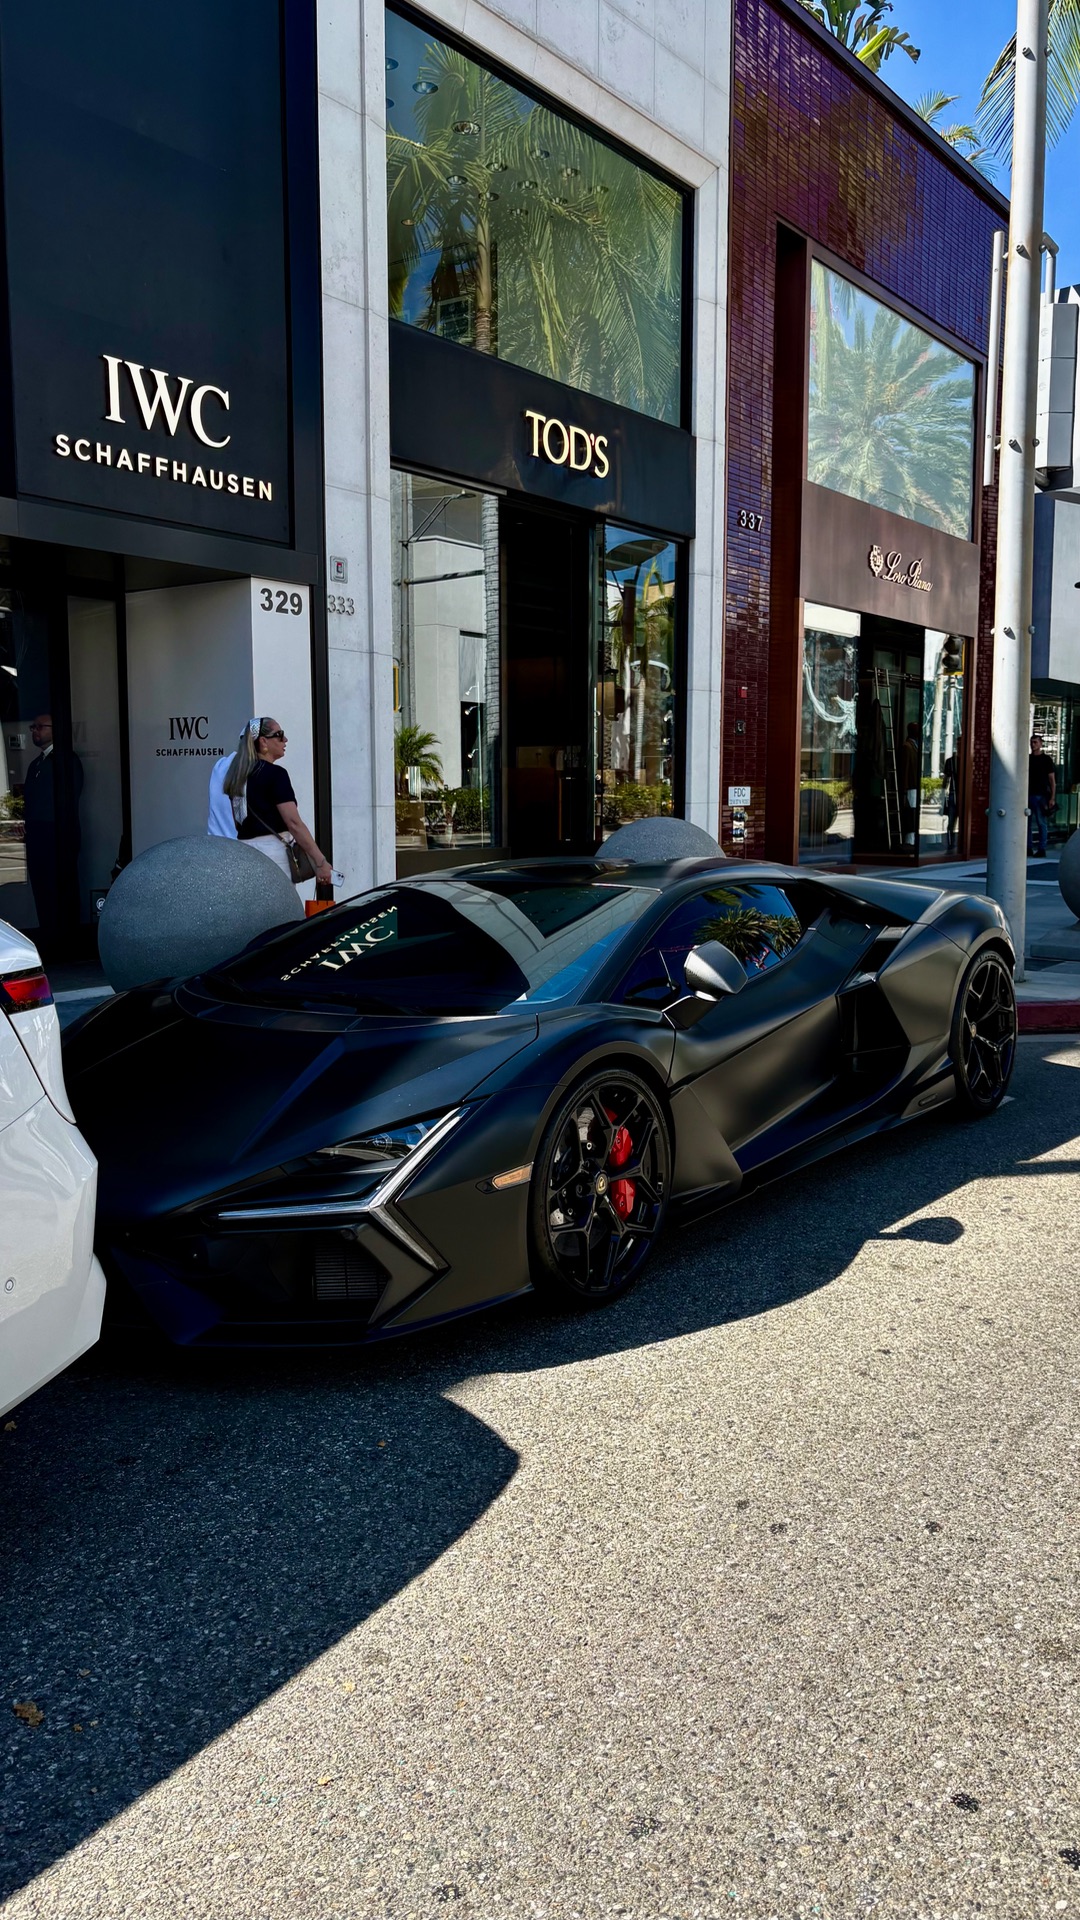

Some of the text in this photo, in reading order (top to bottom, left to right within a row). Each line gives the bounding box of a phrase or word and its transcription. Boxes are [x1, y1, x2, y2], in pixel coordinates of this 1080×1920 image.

[102, 354, 231, 448] IWC
[525, 409, 610, 479] TOD'S
[55, 433, 273, 501] SCHAFFHAUSEN
[739, 509, 763, 532] 337
[882, 550, 933, 592] Loro Piana
[260, 587, 303, 616] 329
[327, 594, 355, 616] 333
[168, 715, 209, 741] IWC
[156, 747, 224, 757] SCHAFFHAUSEN
[733, 787, 746, 798] FDC
